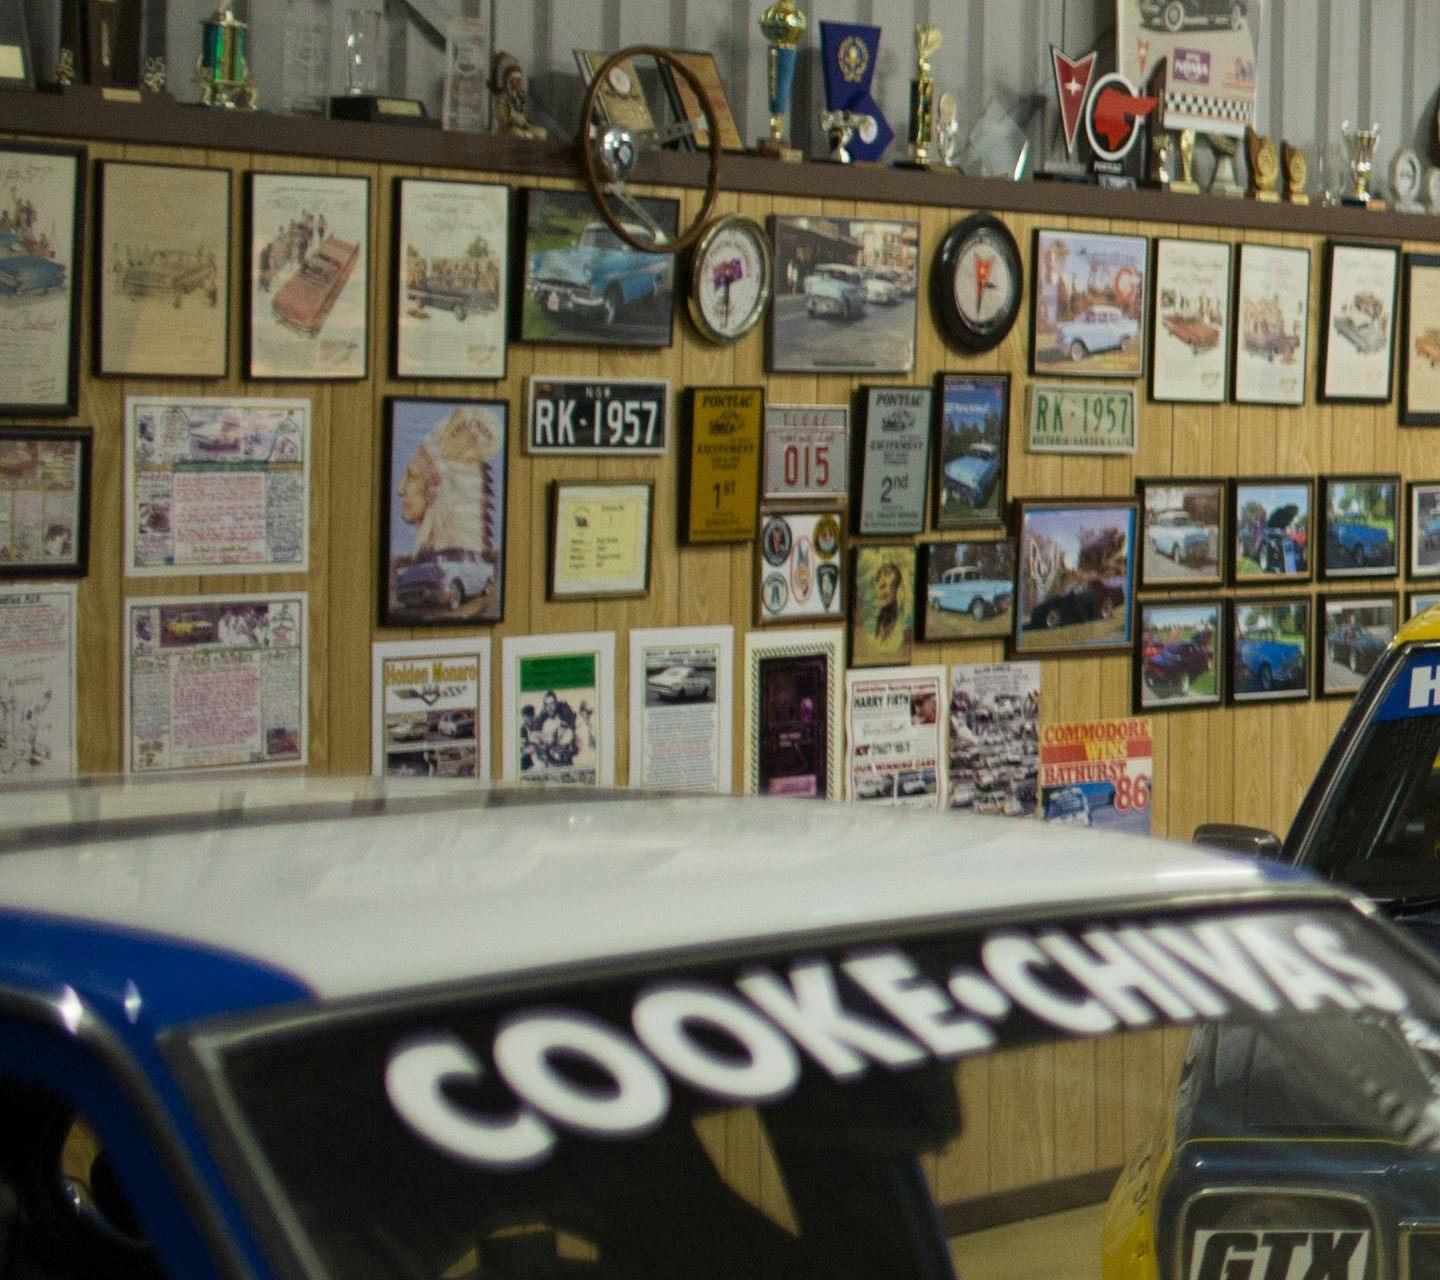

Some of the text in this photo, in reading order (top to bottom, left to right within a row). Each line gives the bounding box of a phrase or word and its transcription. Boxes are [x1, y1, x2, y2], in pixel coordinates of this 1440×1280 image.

[701, 394, 751, 409] PONTIAC
[875, 393, 923, 407] PONTIAC
[783, 443, 830, 488] 015
[880, 473, 909, 504] 2nd
[432, 662, 478, 686] Monaro
[853, 692, 911, 710] HARRY FIRTH
[1042, 719, 1150, 744] COMMODORE
[1084, 739, 1128, 761] WINS
[1042, 760, 1128, 786] BATHURST
[1113, 773, 1150, 814] 86
